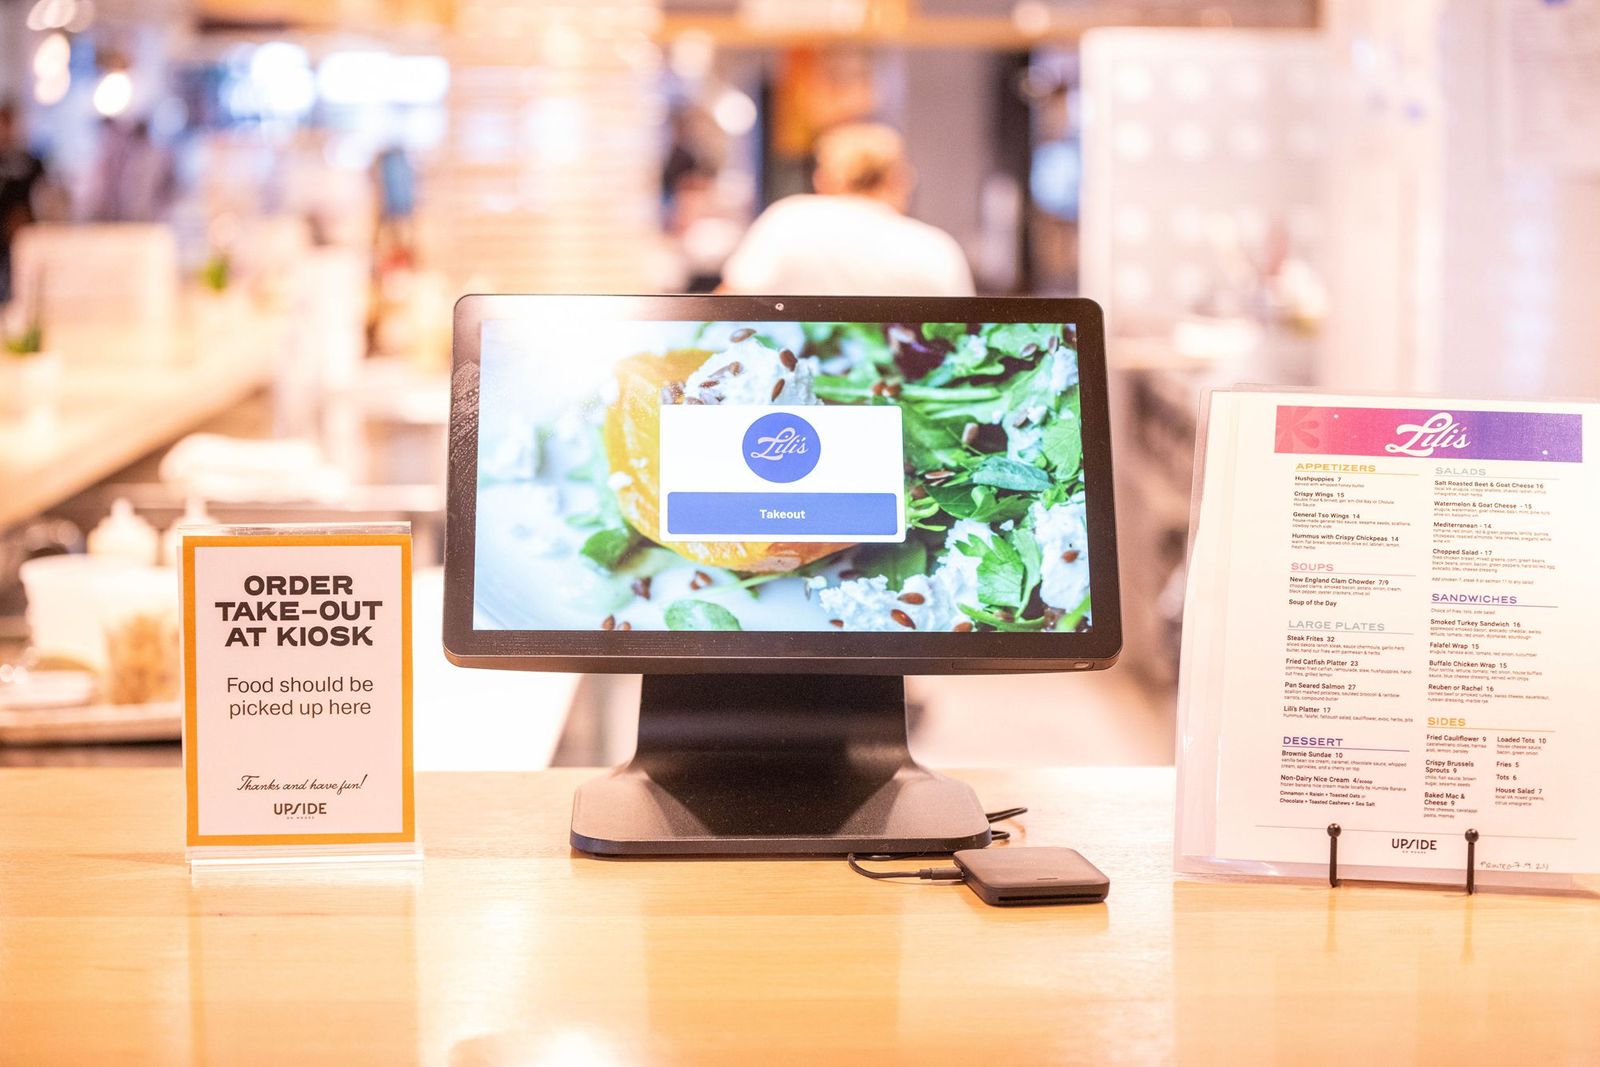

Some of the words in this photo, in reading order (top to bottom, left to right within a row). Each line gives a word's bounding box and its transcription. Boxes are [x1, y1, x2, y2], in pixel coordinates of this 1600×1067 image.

[1385, 412, 1471, 457] Lili's
[750, 427, 809, 461] Lili's
[1296, 463, 1375, 474] APPETIZERS
[1435, 467, 1486, 476] SALADS
[1294, 476, 1334, 484] Hushpuppies
[1314, 491, 1333, 499] Wings
[760, 509, 806, 519] Takeout
[1355, 535, 1387, 543] Chickpeas
[1290, 562, 1333, 571] SOUPS
[244, 576, 353, 596] ORDER
[1304, 577, 1329, 585] England
[1288, 599, 1304, 607] Soup
[1324, 600, 1336, 608] Day
[1431, 593, 1517, 604] SANDWICHES
[215, 601, 383, 622] TAKE-OUT
[1288, 620, 1331, 629] LARGE
[1335, 621, 1384, 631] PLATES
[1457, 620, 1478, 628] Turkey
[225, 627, 267, 647] AT
[277, 626, 373, 647] KIOSK
[227, 677, 274, 693] Food
[280, 676, 343, 693] should
[350, 676, 374, 692] be
[230, 700, 293, 719] picked
[300, 703, 324, 719] up
[330, 699, 372, 715] here
[1427, 717, 1465, 726] SIDES
[1282, 736, 1342, 747] DESSERT
[1425, 767, 1449, 775] Sprouts
[237, 775, 280, 791] Thanks
[282, 779, 308, 790] and
[310, 779, 338, 790] have
[336, 774, 368, 795] fun!
[1280, 775, 1312, 783] Non-Dairy
[274, 803, 327, 815] UPSIDE
[1392, 838, 1438, 850] UPSIDE
